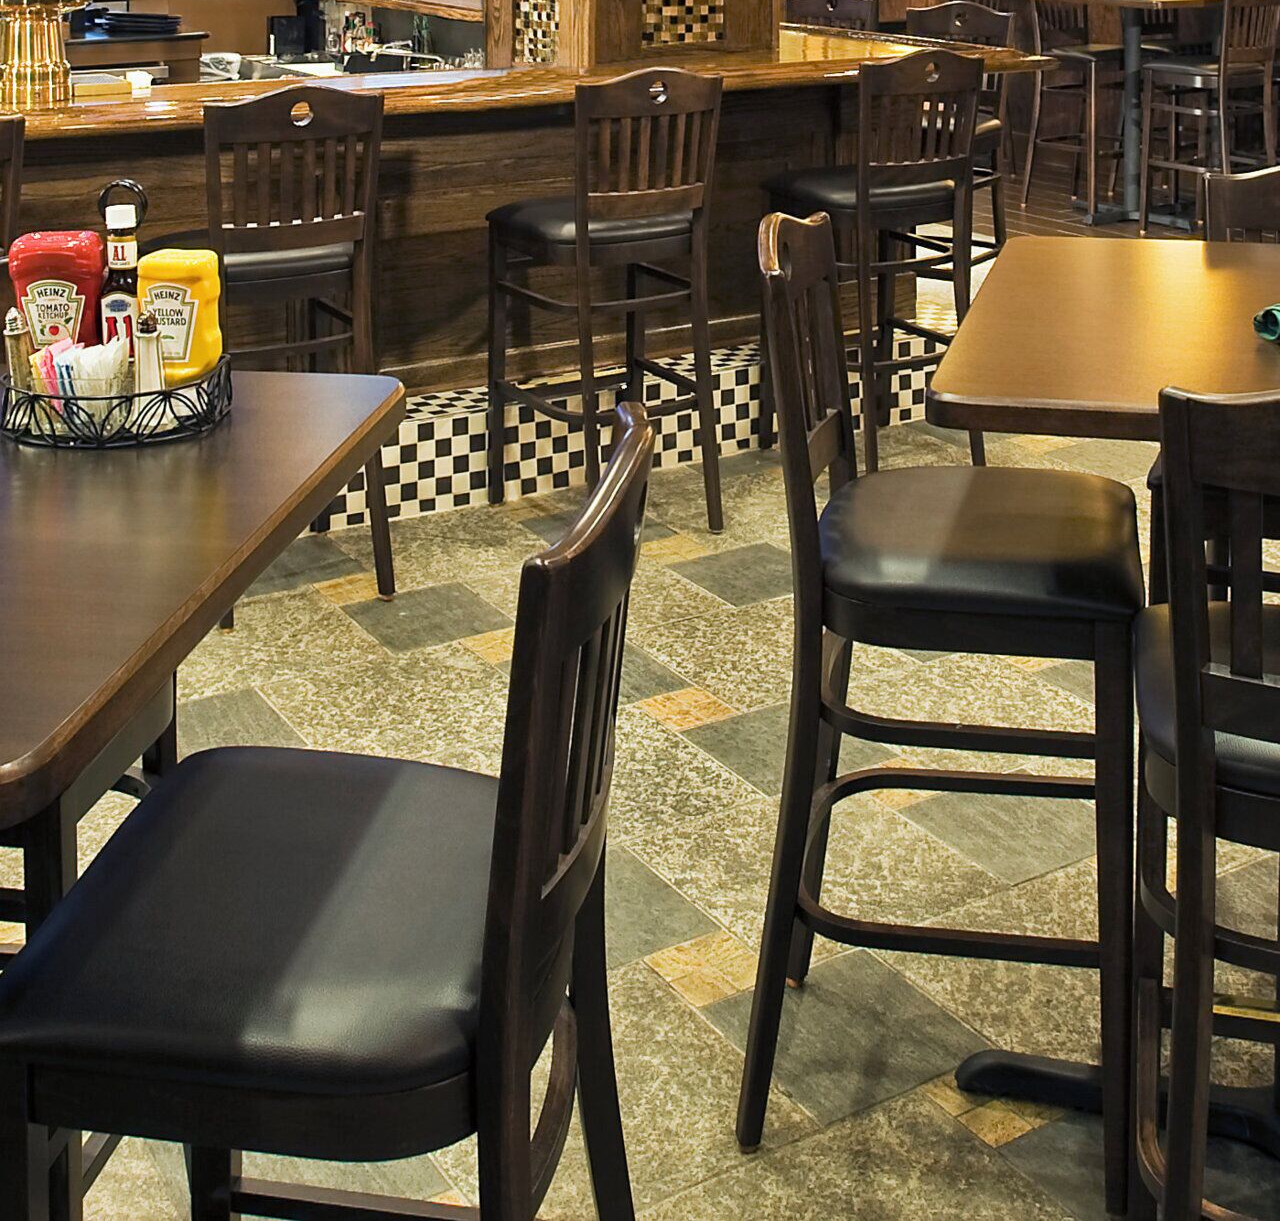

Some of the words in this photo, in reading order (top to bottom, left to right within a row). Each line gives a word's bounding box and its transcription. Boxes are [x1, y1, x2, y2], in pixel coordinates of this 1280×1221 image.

[36, 287, 67, 299] HEINZ
[154, 290, 181, 301] HEINZ
[35, 303, 70, 313] TOMATO
[153, 308, 184, 317] YELLOW
[37, 311, 69, 320] KETCHUP
[156, 317, 187, 326] USTARD
